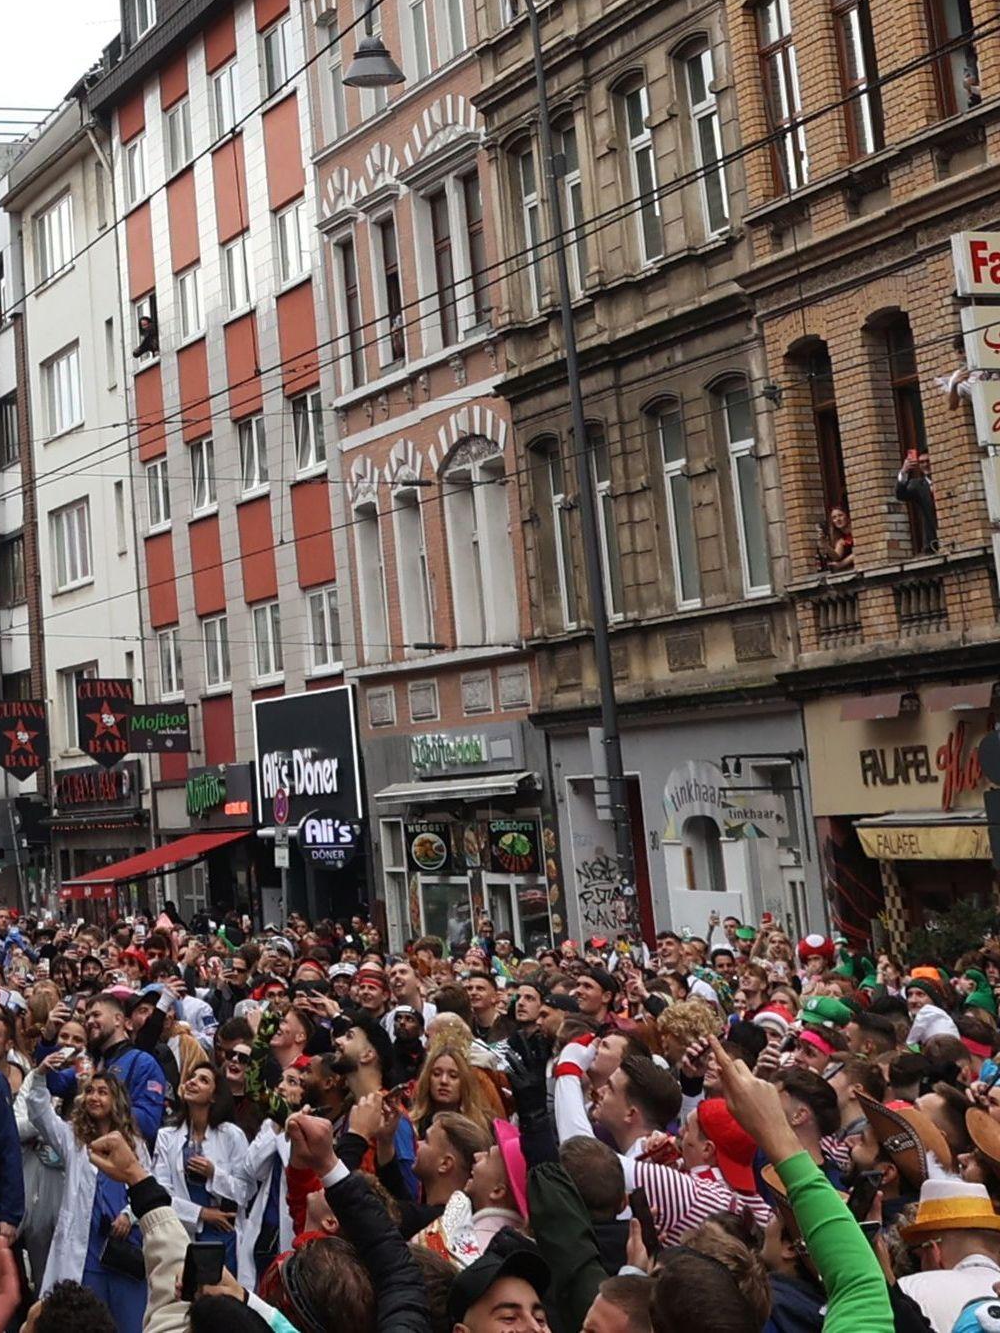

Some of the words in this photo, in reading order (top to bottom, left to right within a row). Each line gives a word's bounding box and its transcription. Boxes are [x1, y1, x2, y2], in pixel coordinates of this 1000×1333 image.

[78, 681, 133, 699] CUBANA
[131, 712, 187, 731] Mojitos
[89, 740, 128, 753] BAR
[4, 754, 41, 767] BAR
[859, 745, 938, 787] FALAFEL
[263, 751, 290, 799] Ali's
[292, 747, 338, 795] Döner
[729, 808, 775, 820] tinkhaar
[305, 818, 353, 843] Ali's
[312, 847, 346, 859] DÖNER
[876, 834, 923, 856] FALAFEL
